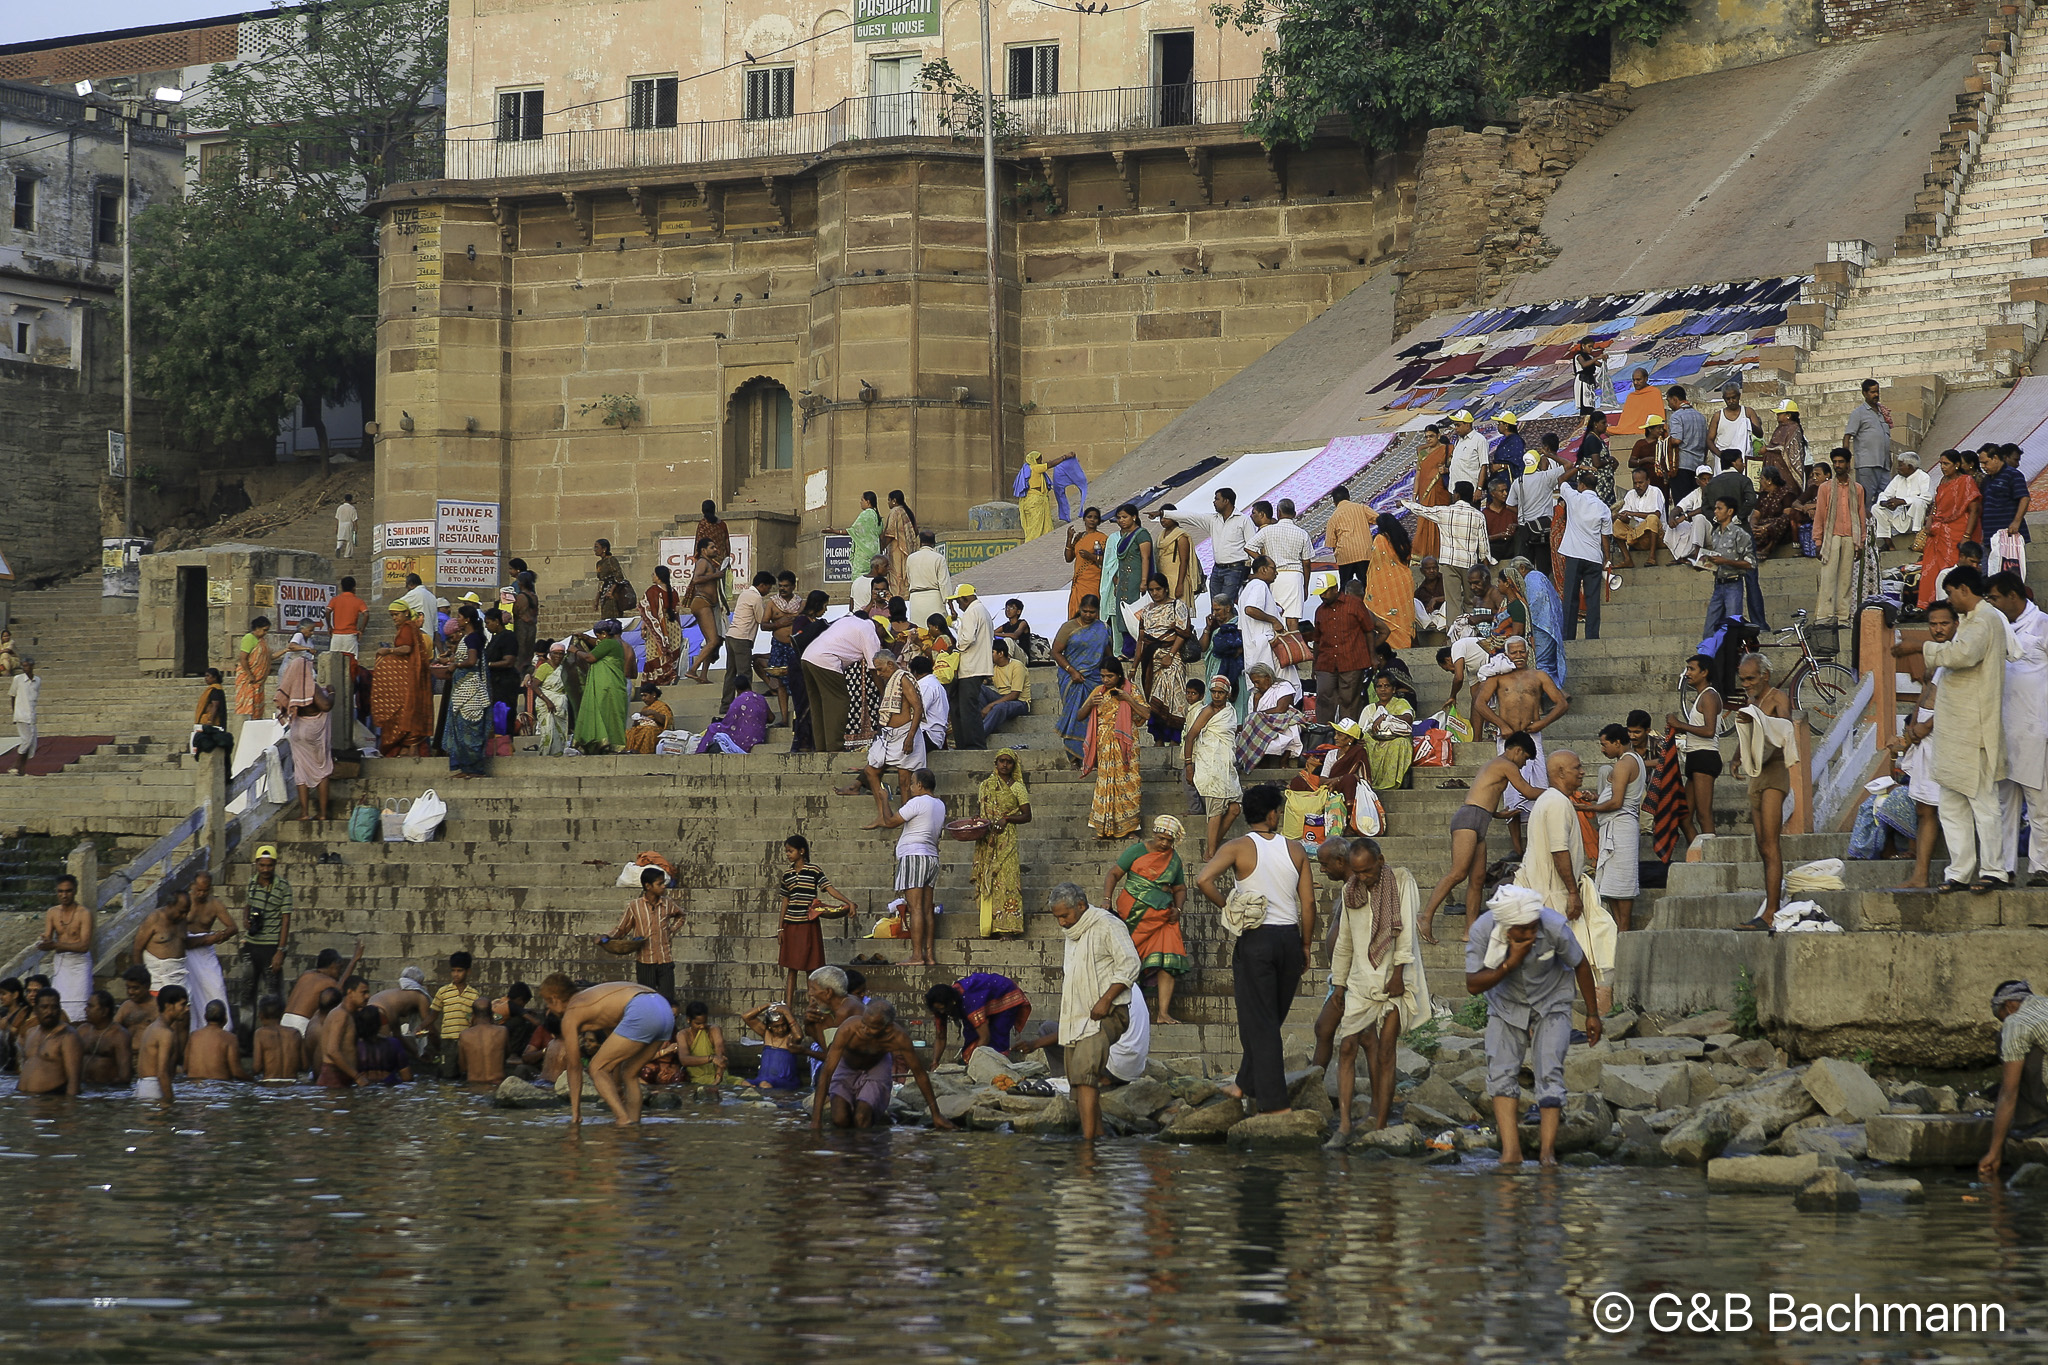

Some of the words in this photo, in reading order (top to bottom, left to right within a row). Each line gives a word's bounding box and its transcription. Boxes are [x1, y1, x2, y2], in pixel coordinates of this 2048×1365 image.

[857, 24, 886, 37] GUEST
[892, 20, 925, 35] HOUSE
[441, 507, 493, 518] DINNER
[405, 526, 429, 535] KRIPA
[446, 524, 480, 532] MUSIC
[386, 538, 408, 546] GUEST
[409, 536, 430, 546] HOUSE
[439, 533, 499, 543] RESTAURANT
[948, 545, 985, 559] SHIVA
[439, 565, 458, 574] FREE
[280, 584, 296, 600] SAI
[297, 586, 326, 602] KRIPA
[283, 604, 306, 617] GUEST
